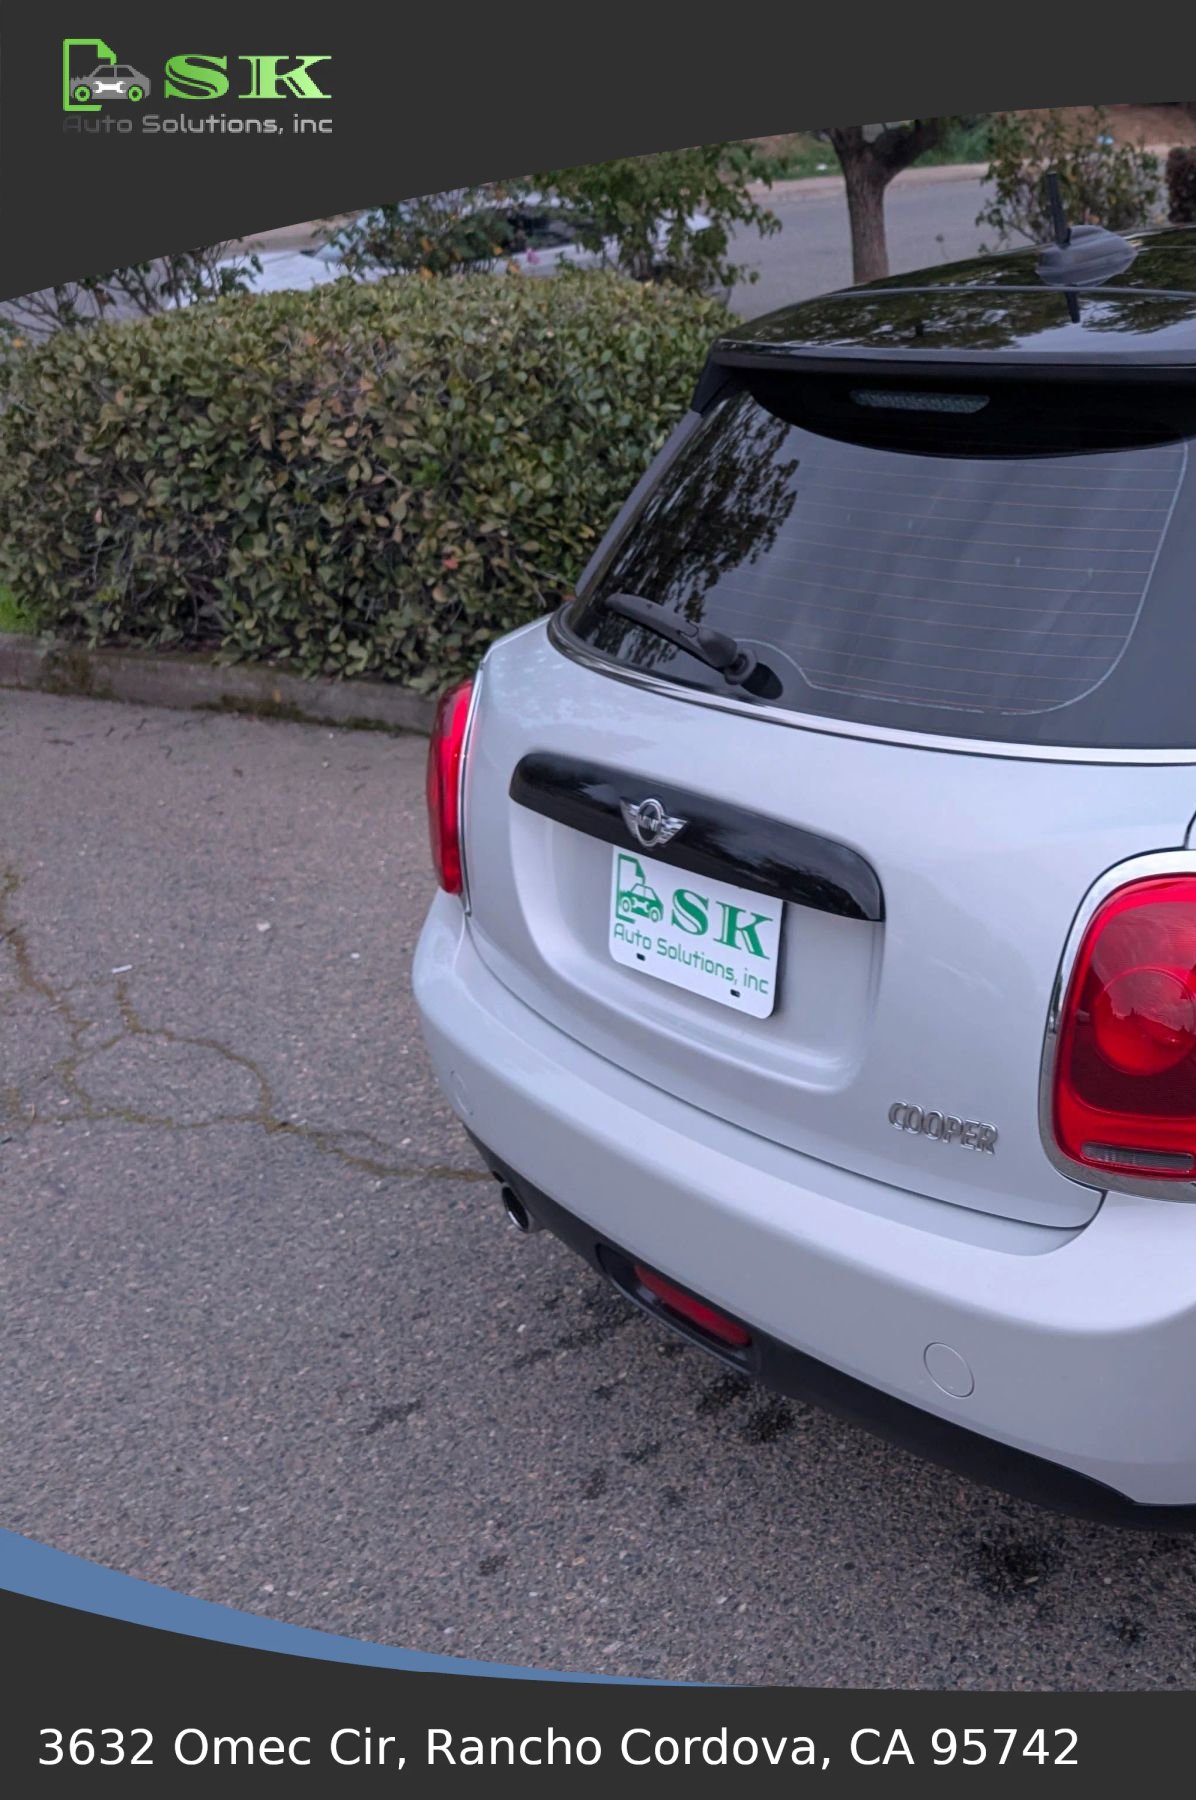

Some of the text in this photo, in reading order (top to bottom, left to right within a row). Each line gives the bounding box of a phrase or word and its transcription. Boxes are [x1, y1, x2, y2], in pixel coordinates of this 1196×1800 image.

[613, 922, 769, 995] Auto Solutions, inc
[671, 888, 774, 960] SK
[887, 1100, 999, 1155] COOPER
